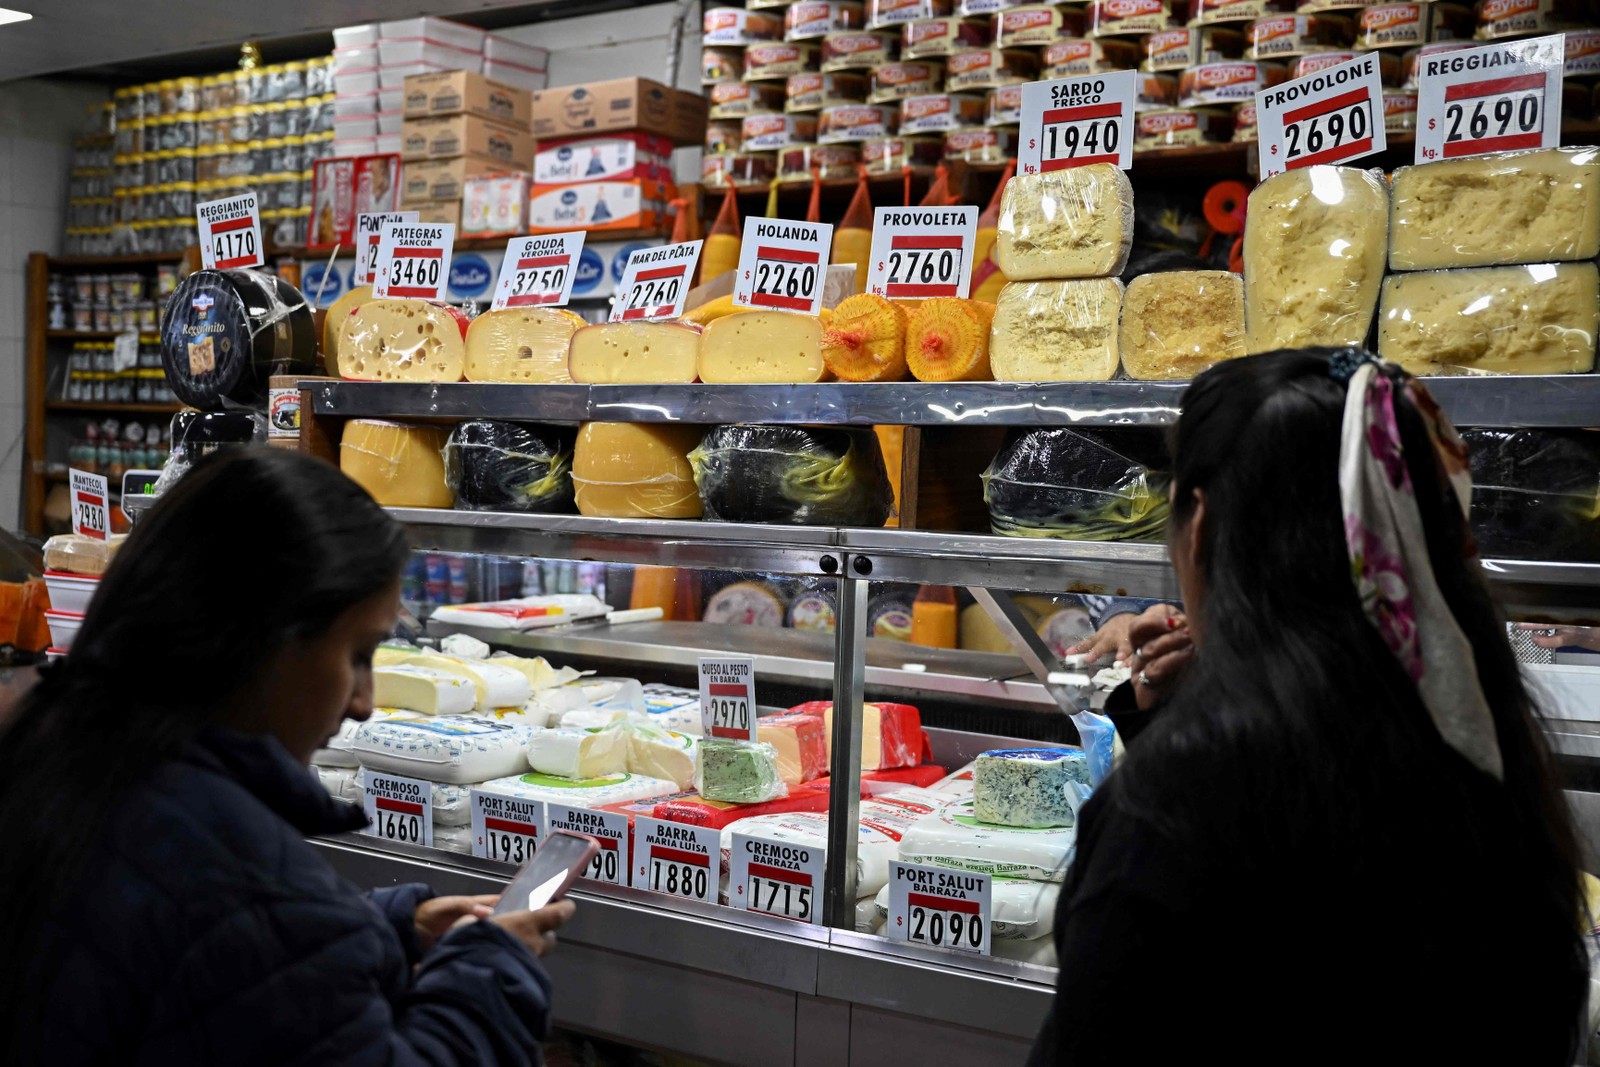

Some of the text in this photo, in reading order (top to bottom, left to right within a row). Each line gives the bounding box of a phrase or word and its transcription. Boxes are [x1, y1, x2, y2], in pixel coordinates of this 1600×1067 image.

[1427, 43, 1550, 76] REGGIAN
[1051, 80, 1105, 99] SARDO
[1265, 61, 1373, 109] PROVOLONE
[1054, 95, 1101, 108] FRESCO
[1429, 93, 1538, 142] $ 2690
[1029, 120, 1118, 158] $ 1940
[1271, 144, 1277, 155] $
[1285, 106, 1366, 158] 2690
[1423, 147, 1438, 159] kg.
[1024, 163, 1036, 174] kg.
[201, 198, 254, 218] REGGIANITO
[208, 210, 248, 223] SANTA ROSA
[883, 213, 967, 226] PROVOLETA
[392, 228, 442, 239] PATEGRAS
[757, 224, 818, 242] HOLANDA
[216, 231, 254, 260] 4170
[521, 248, 564, 257] VERONICA
[525, 238, 564, 251] GOUDA
[631, 246, 694, 265] MAR DEL PLATA
[392, 259, 439, 285] 3460
[878, 250, 952, 283] $ 2760
[504, 268, 564, 296] $ 3250
[745, 264, 814, 297] $ 2260
[872, 284, 884, 295] kg.
[377, 287, 385, 296] kg.
[628, 279, 678, 309] 2260
[739, 292, 748, 303] kg.
[74, 475, 102, 489] MANTECOL
[79, 504, 104, 530] 2980
[702, 664, 748, 676] QUESO AL PESTO
[712, 699, 748, 729] 2970
[367, 788, 391, 798] PUNTA
[405, 796, 426, 804] AGUA
[373, 778, 419, 795] CREMOSO
[479, 796, 534, 816] PORT SALUT
[483, 808, 531, 823] PUNTA DE AGUA
[377, 811, 418, 842] 1660
[568, 811, 605, 828] BARRA
[552, 820, 623, 839] PUNTA DE AGUA
[657, 825, 696, 842] BARRA
[479, 832, 537, 862] $ 1930
[646, 835, 707, 854] MARIA LUISA
[746, 840, 809, 863] CREMOSO
[583, 851, 616, 879] 90
[753, 855, 800, 870] BARRAZA
[640, 862, 706, 898] $ 1880
[897, 867, 984, 892] PORT SALUT
[738, 878, 809, 919] $ 1715
[914, 883, 966, 899] BARRAZA
[897, 907, 982, 948] $ 2090
